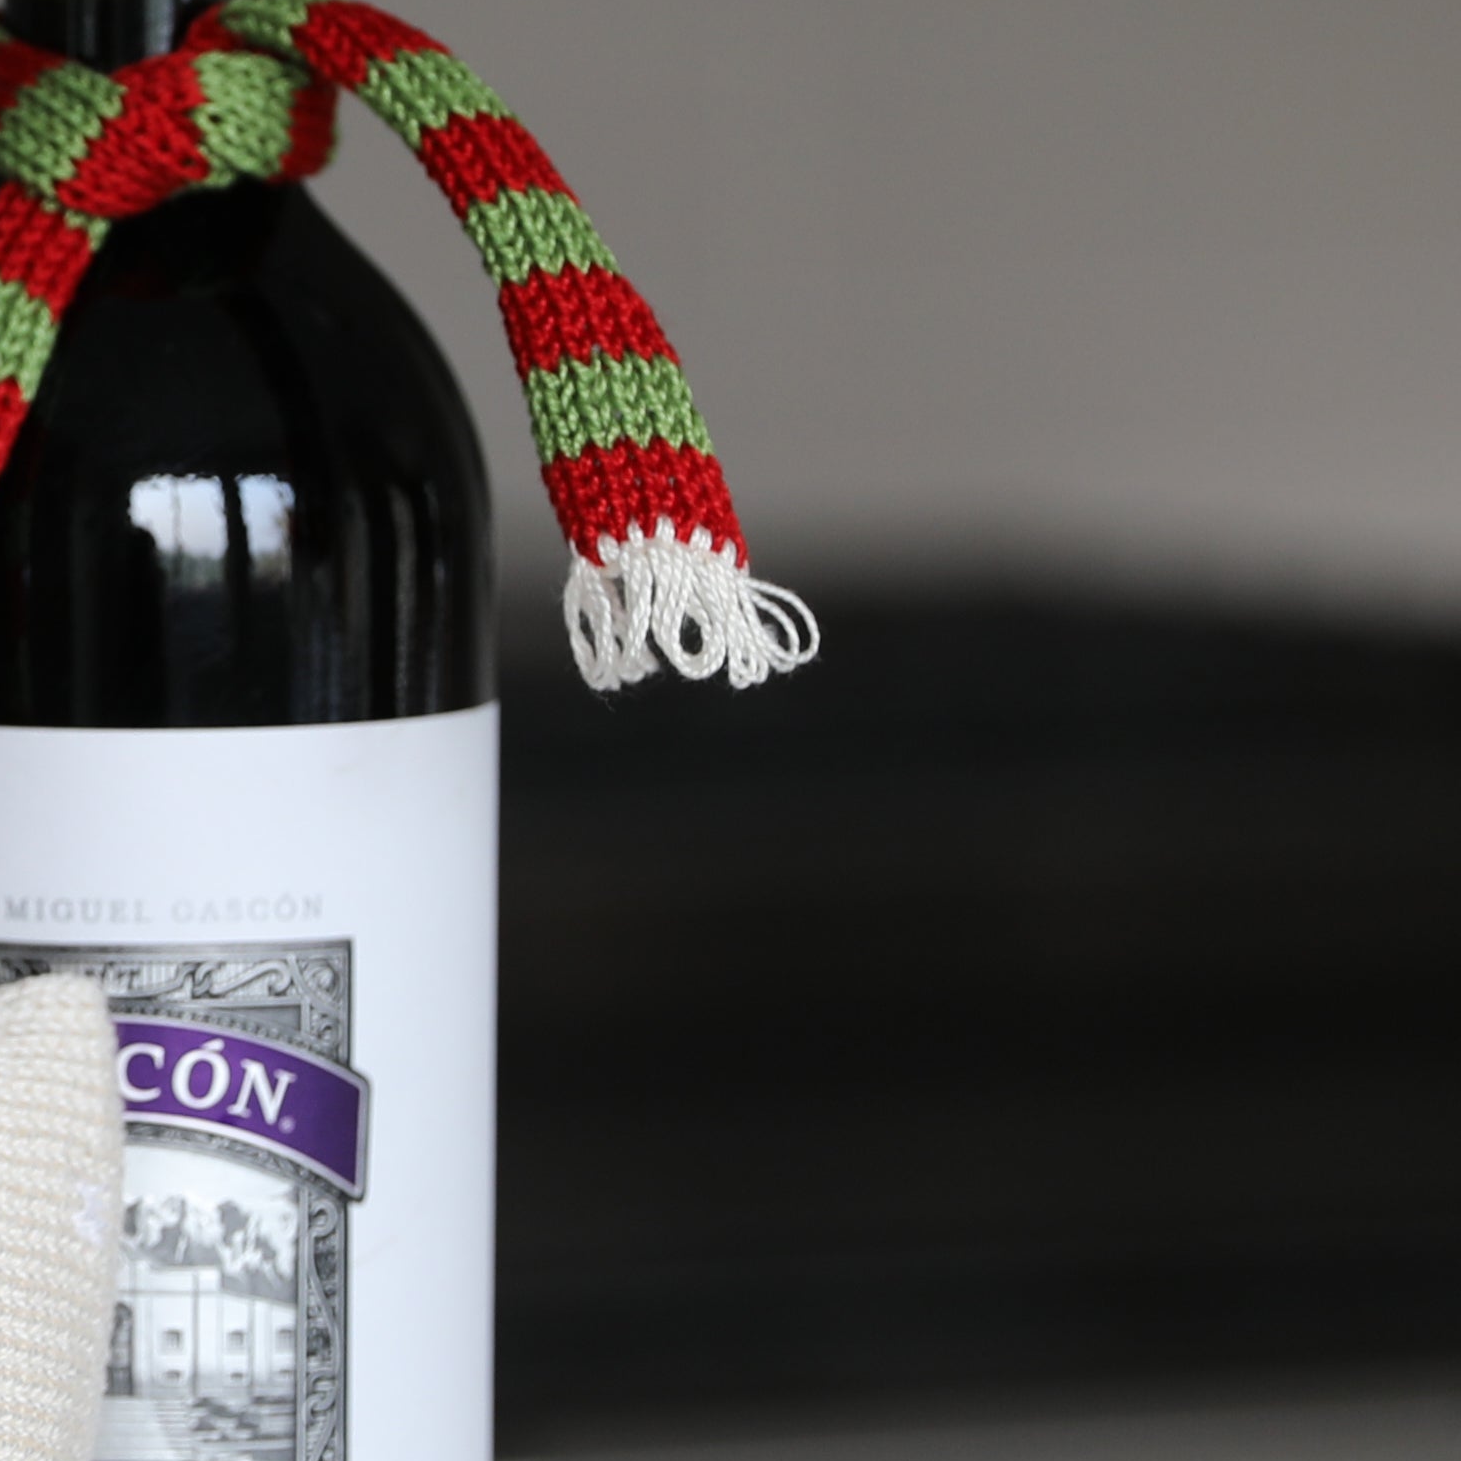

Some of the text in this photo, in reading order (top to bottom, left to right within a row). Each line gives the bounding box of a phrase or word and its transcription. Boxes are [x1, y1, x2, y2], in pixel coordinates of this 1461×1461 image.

[4, 893, 152, 925] MIGUEL
[169, 892, 324, 925] GASCÓN
[116, 1038, 297, 1126] CÓN
